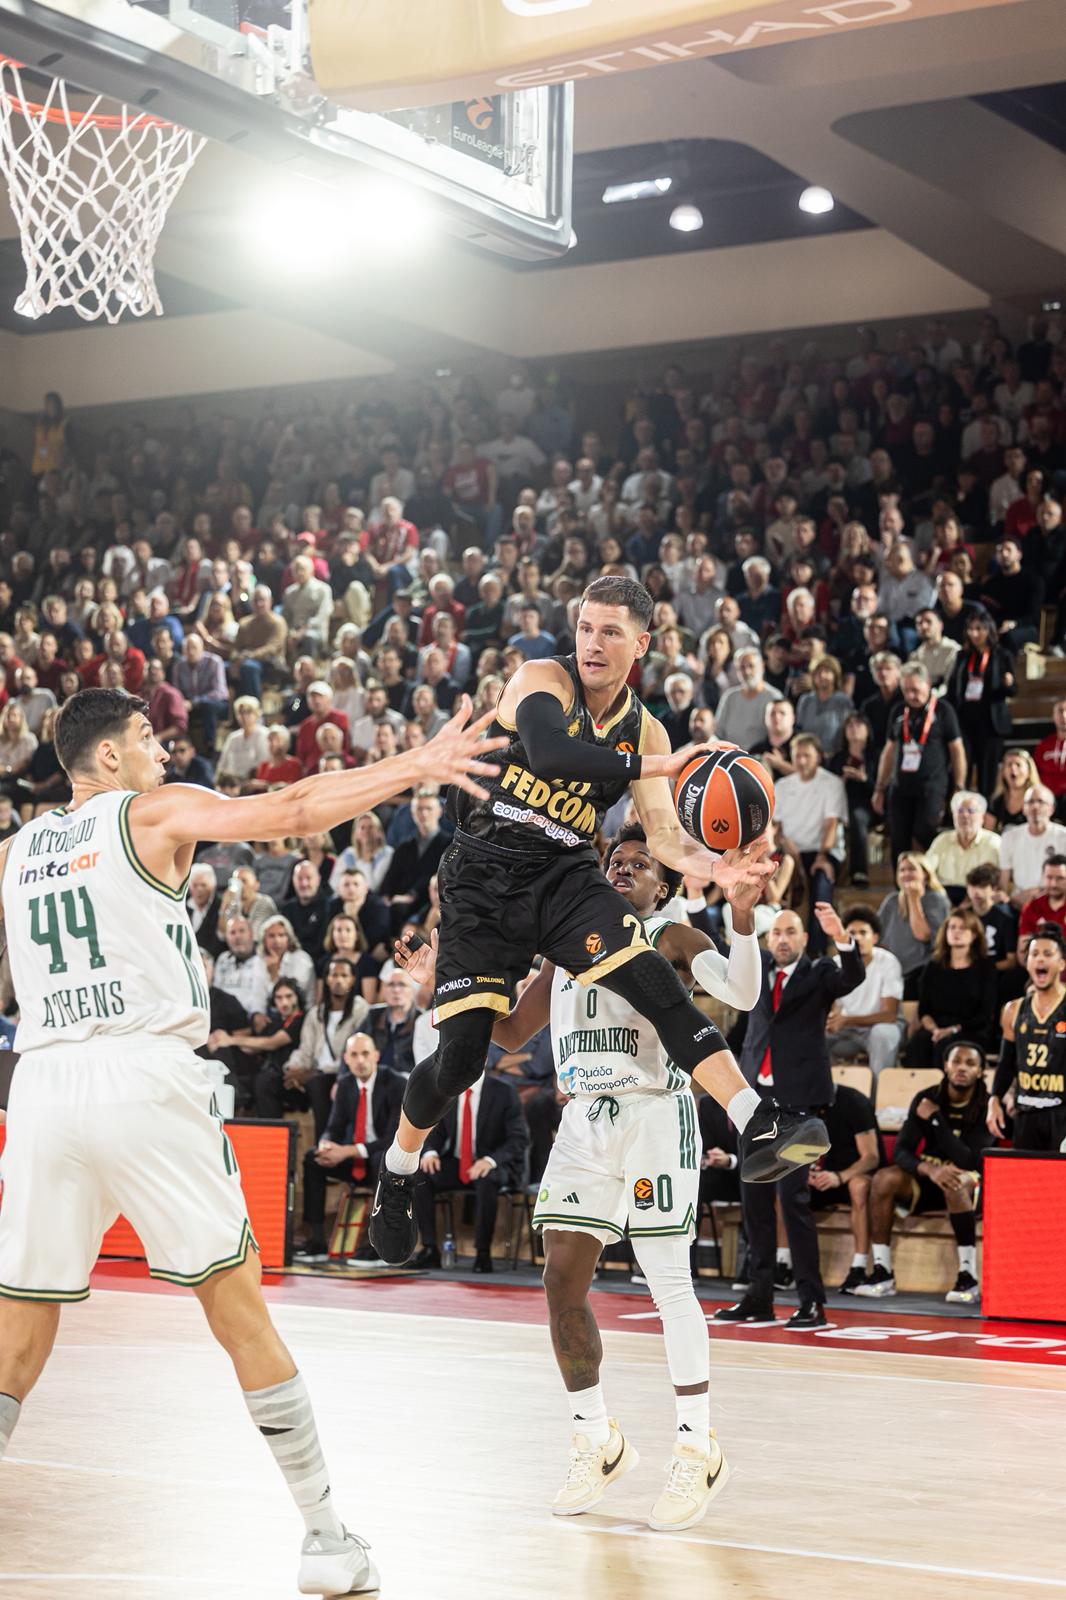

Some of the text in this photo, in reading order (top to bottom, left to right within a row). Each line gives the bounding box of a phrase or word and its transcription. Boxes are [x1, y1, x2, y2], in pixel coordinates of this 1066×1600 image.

[495, 0, 912, 88] ETIHAD
[500, 763, 597, 835] FEDCOM
[19, 851, 100, 886] instacar
[28, 885, 107, 975] 44
[476, 976, 505, 985] SPALDING
[42, 980, 126, 1028] ATHENS
[586, 988, 597, 1019] 0
[577, 1066, 613, 1080] Ομάδα
[1026, 1042, 1048, 1068] 32
[657, 1174, 673, 1212] 0
